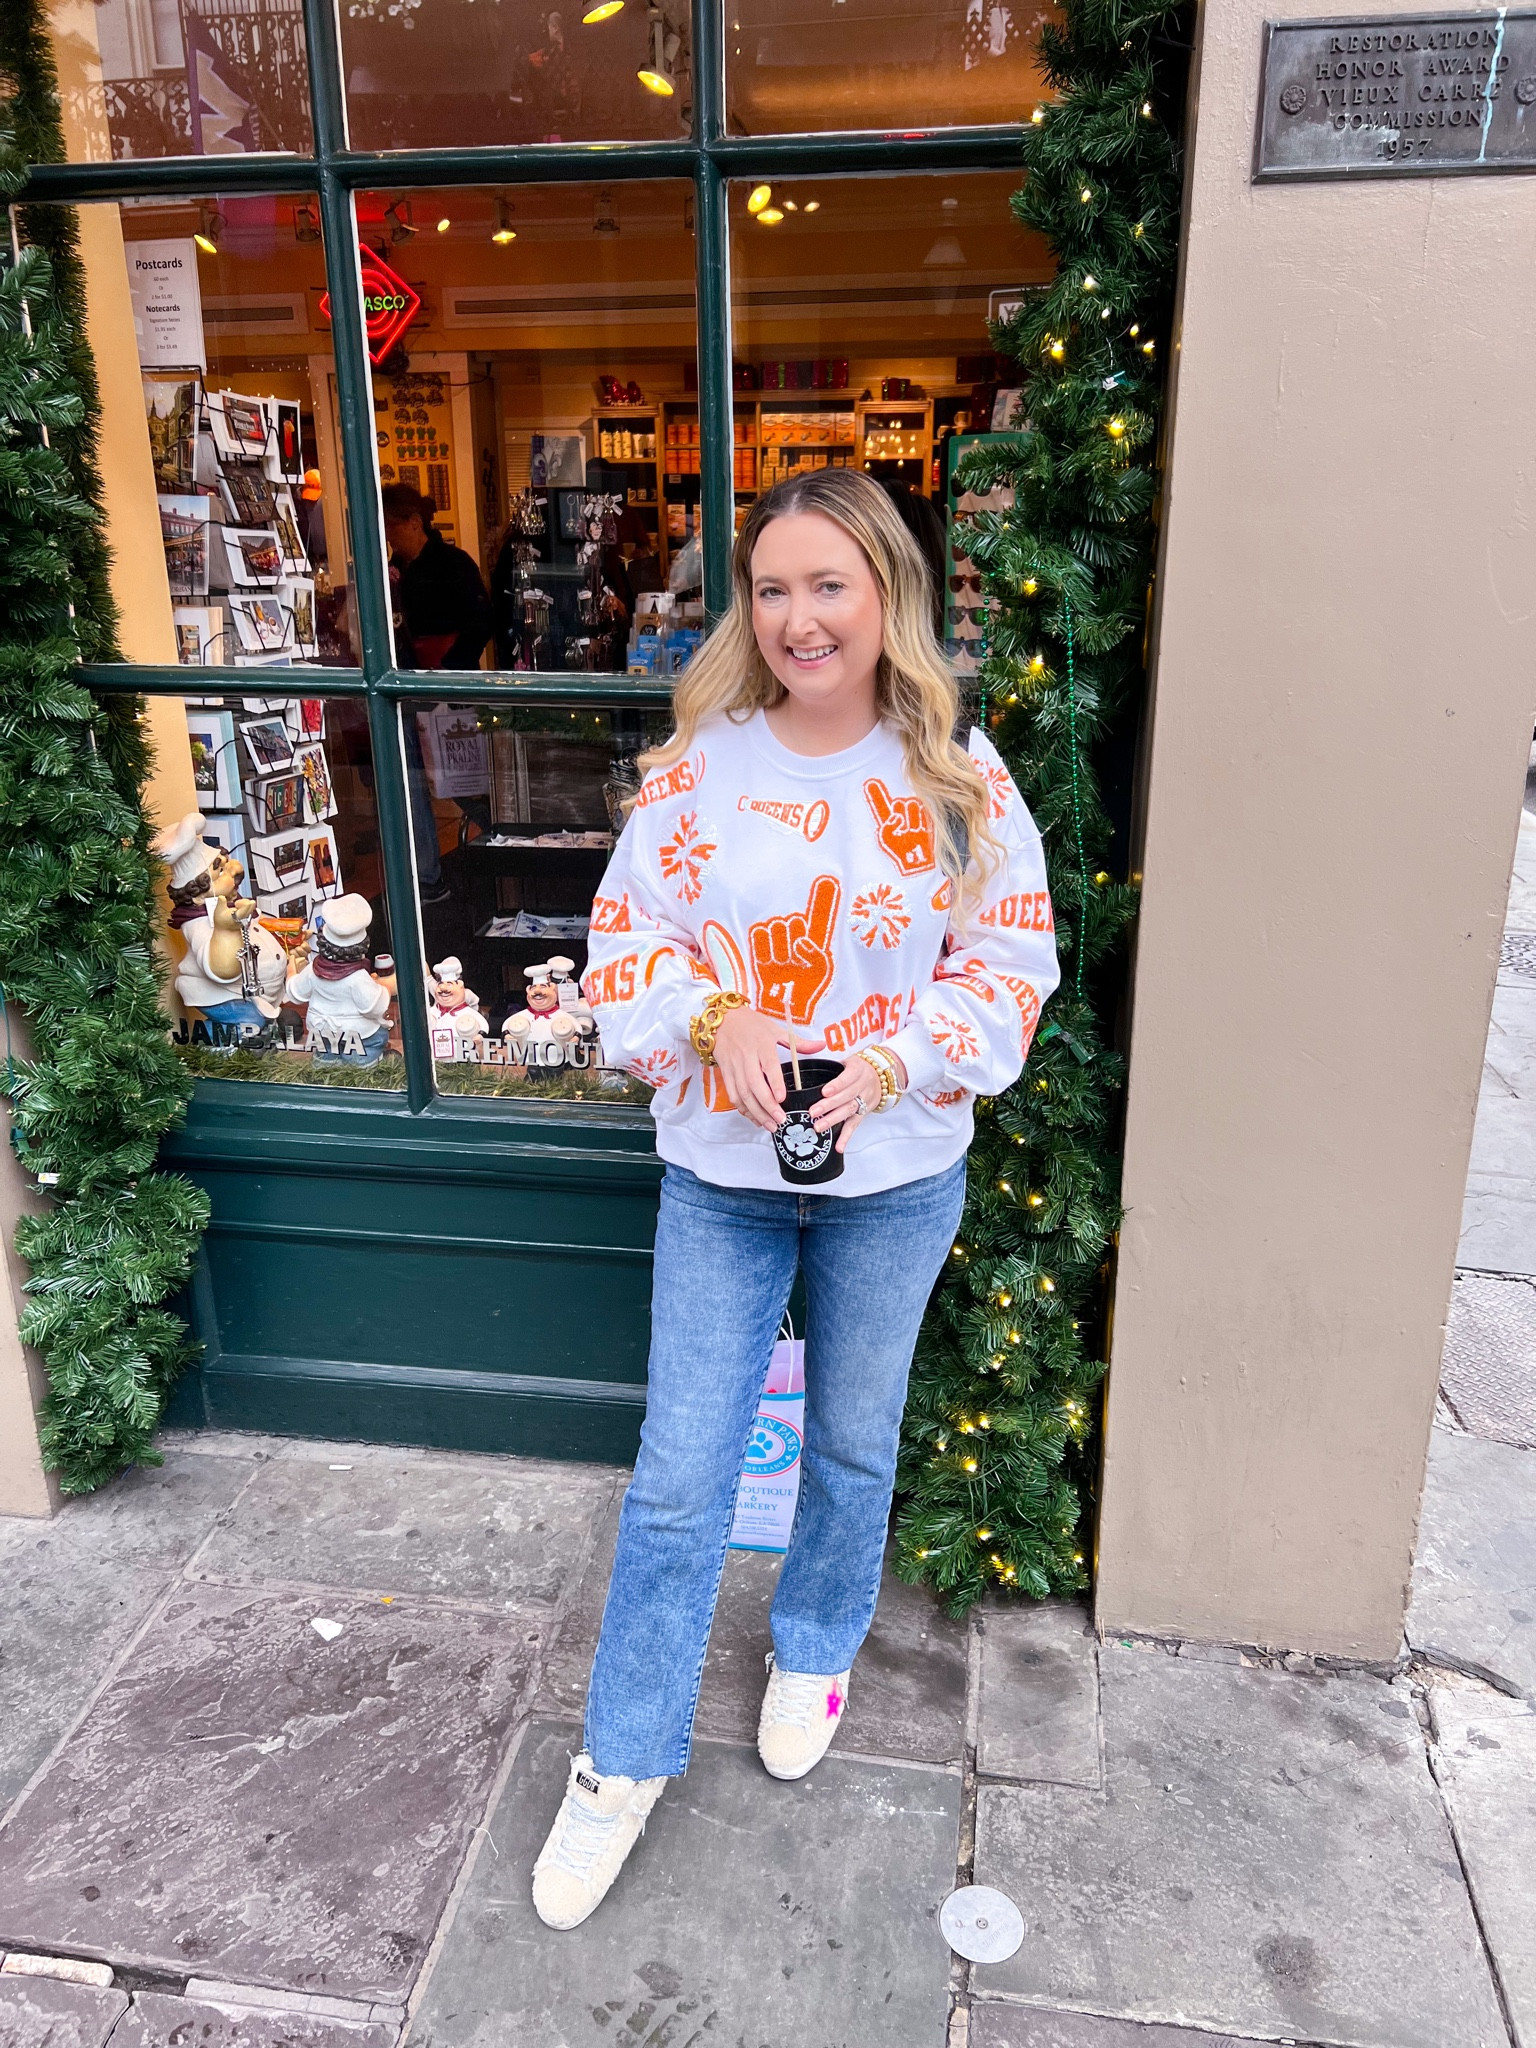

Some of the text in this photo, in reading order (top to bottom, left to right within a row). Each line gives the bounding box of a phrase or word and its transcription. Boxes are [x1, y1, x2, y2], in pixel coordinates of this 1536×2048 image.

[1329, 29, 1500, 55] RESTORATION
[1316, 55, 1511, 81] HONOR AWARD
[1320, 85, 1400, 108] VIEUX
[1333, 109, 1484, 131] COMMISSION
[1376, 137, 1433, 161] 1957
[135, 257, 183, 271] Postcards
[146, 304, 181, 312] Notecards
[363, 294, 405, 312] ASCO
[445, 739, 480, 753] ROYAL
[635, 760, 697, 809] UEENS
[750, 800, 805, 829] QUEENS
[905, 844, 928, 864] #1
[978, 891, 1055, 933] QUEE
[768, 980, 796, 1006] #1
[172, 1017, 368, 1057] JAMBALAYA
[454, 1036, 620, 1071] REMOUL
[800, 1113, 830, 1137] ROE
[777, 1139, 831, 1169] NEW ORLEANS
[777, 1425, 799, 1452] PAWS
[744, 1461, 786, 1473] ORLEANS
[737, 1502, 778, 1511] ARKERY
[750, 1494, 758, 1502] &
